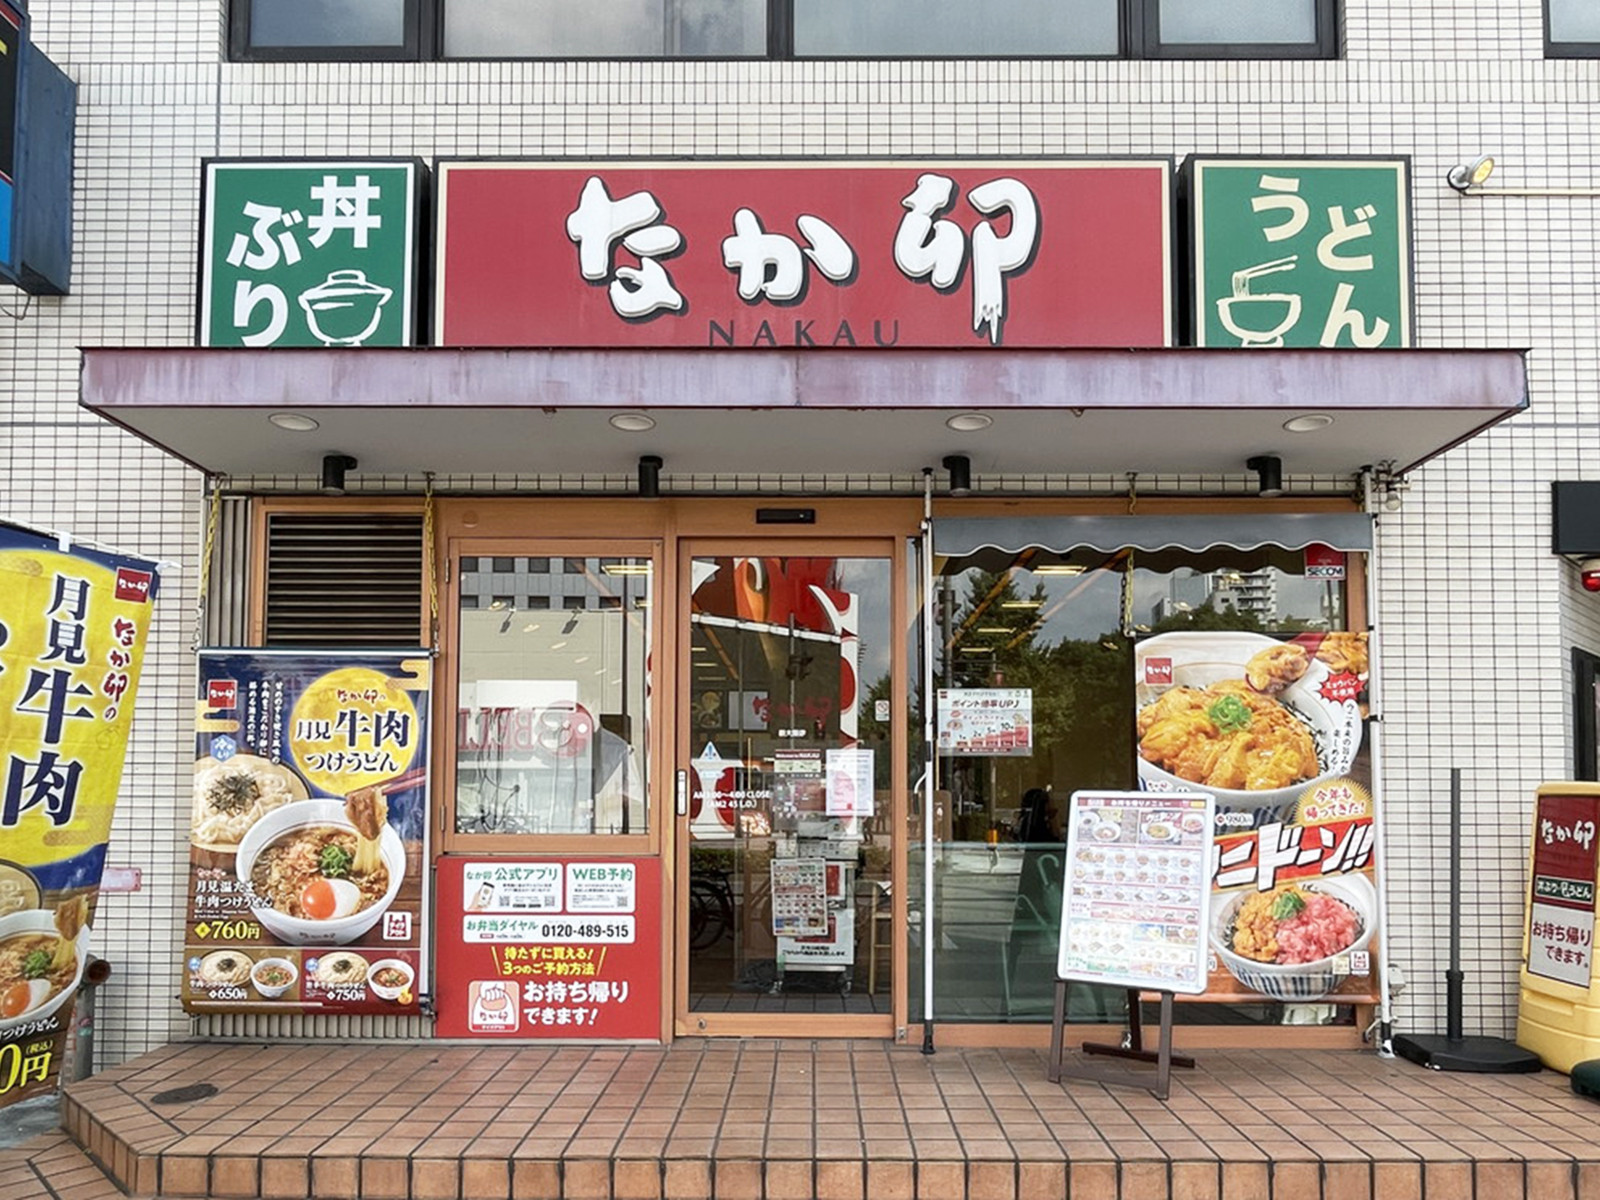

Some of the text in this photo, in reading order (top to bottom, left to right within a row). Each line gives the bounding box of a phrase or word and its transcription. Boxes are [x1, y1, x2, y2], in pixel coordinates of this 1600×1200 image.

[566, 174, 1040, 344] なか卯
[709, 319, 899, 347] NAKAU
[1307, 566, 1343, 577] SECOM
[102, 617, 136, 720] なか卯の
[2, 573, 95, 826] 月見牛肉
[296, 709, 411, 748] 月見牛肉
[306, 752, 399, 772] つけうどん
[1316, 787, 1352, 802] 今年も
[1305, 802, 1365, 819] 帰ってきた!
[1541, 818, 1595, 850] なか卯
[572, 868, 633, 881] WEB予約
[195, 880, 257, 893] 月見温たま
[195, 894, 274, 909] 牛肉つけうどん
[211, 920, 260, 940] 760円
[466, 919, 629, 938] お弁当ダイヤル 0120-489-515
[1532, 921, 1592, 947] お持ち帰り
[504, 946, 594, 961] 待たずに買える!
[1544, 945, 1589, 968] できます。
[502, 961, 596, 976] 3つのご予約方法
[523, 980, 629, 1004] お持ち帰り
[523, 1008, 599, 1026] できます!
[0, 1016, 60, 1041] つけうどん
[26, 1039, 54, 1056] (税込)
